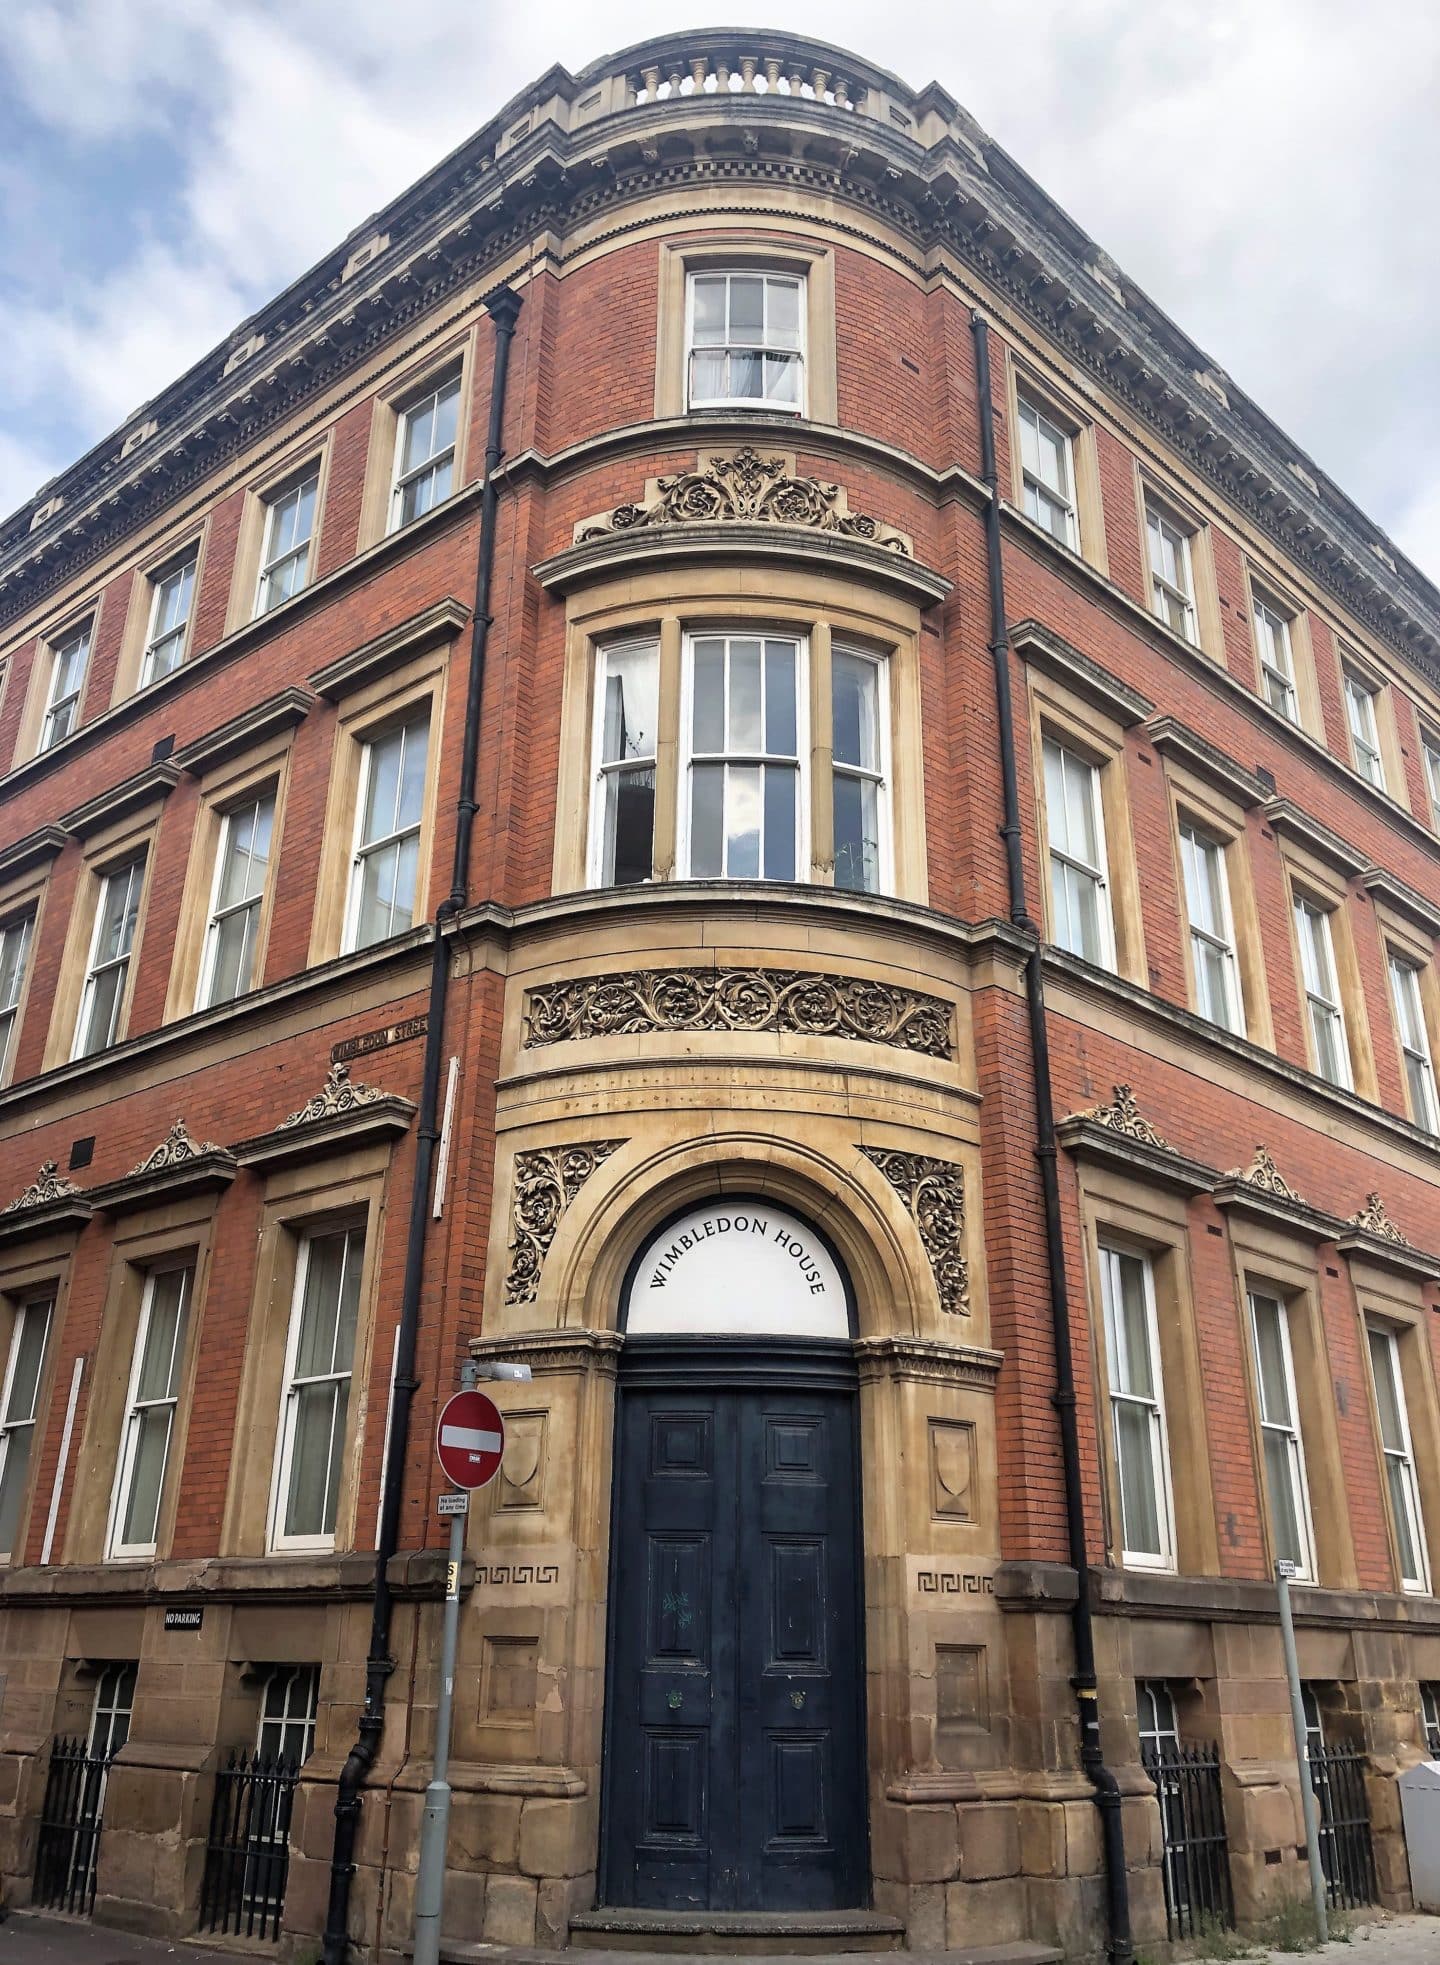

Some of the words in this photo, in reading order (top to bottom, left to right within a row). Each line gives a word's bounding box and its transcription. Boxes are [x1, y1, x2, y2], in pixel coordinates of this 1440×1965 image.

[649, 1216, 768, 1289] WIMBLEDON
[773, 1229, 826, 1295] HOUSE
[165, 1613, 174, 1624] NO
[174, 1612, 201, 1624] PARKING
